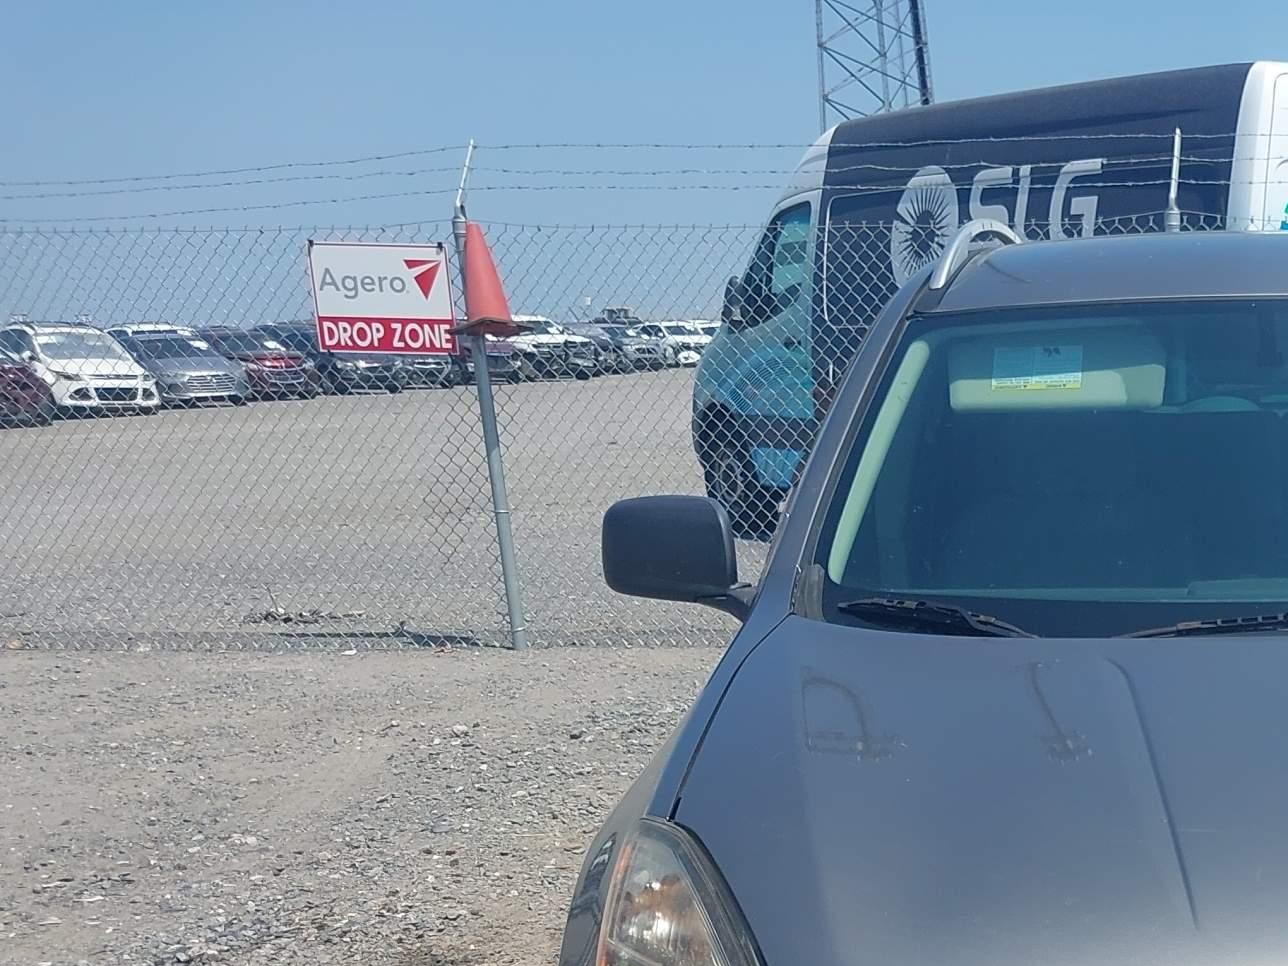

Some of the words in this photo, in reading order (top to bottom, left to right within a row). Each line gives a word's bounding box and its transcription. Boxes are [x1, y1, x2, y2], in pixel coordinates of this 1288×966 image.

[320, 267, 407, 300] Agero
[322, 320, 385, 347] DROP
[390, 322, 453, 349] ZONE
